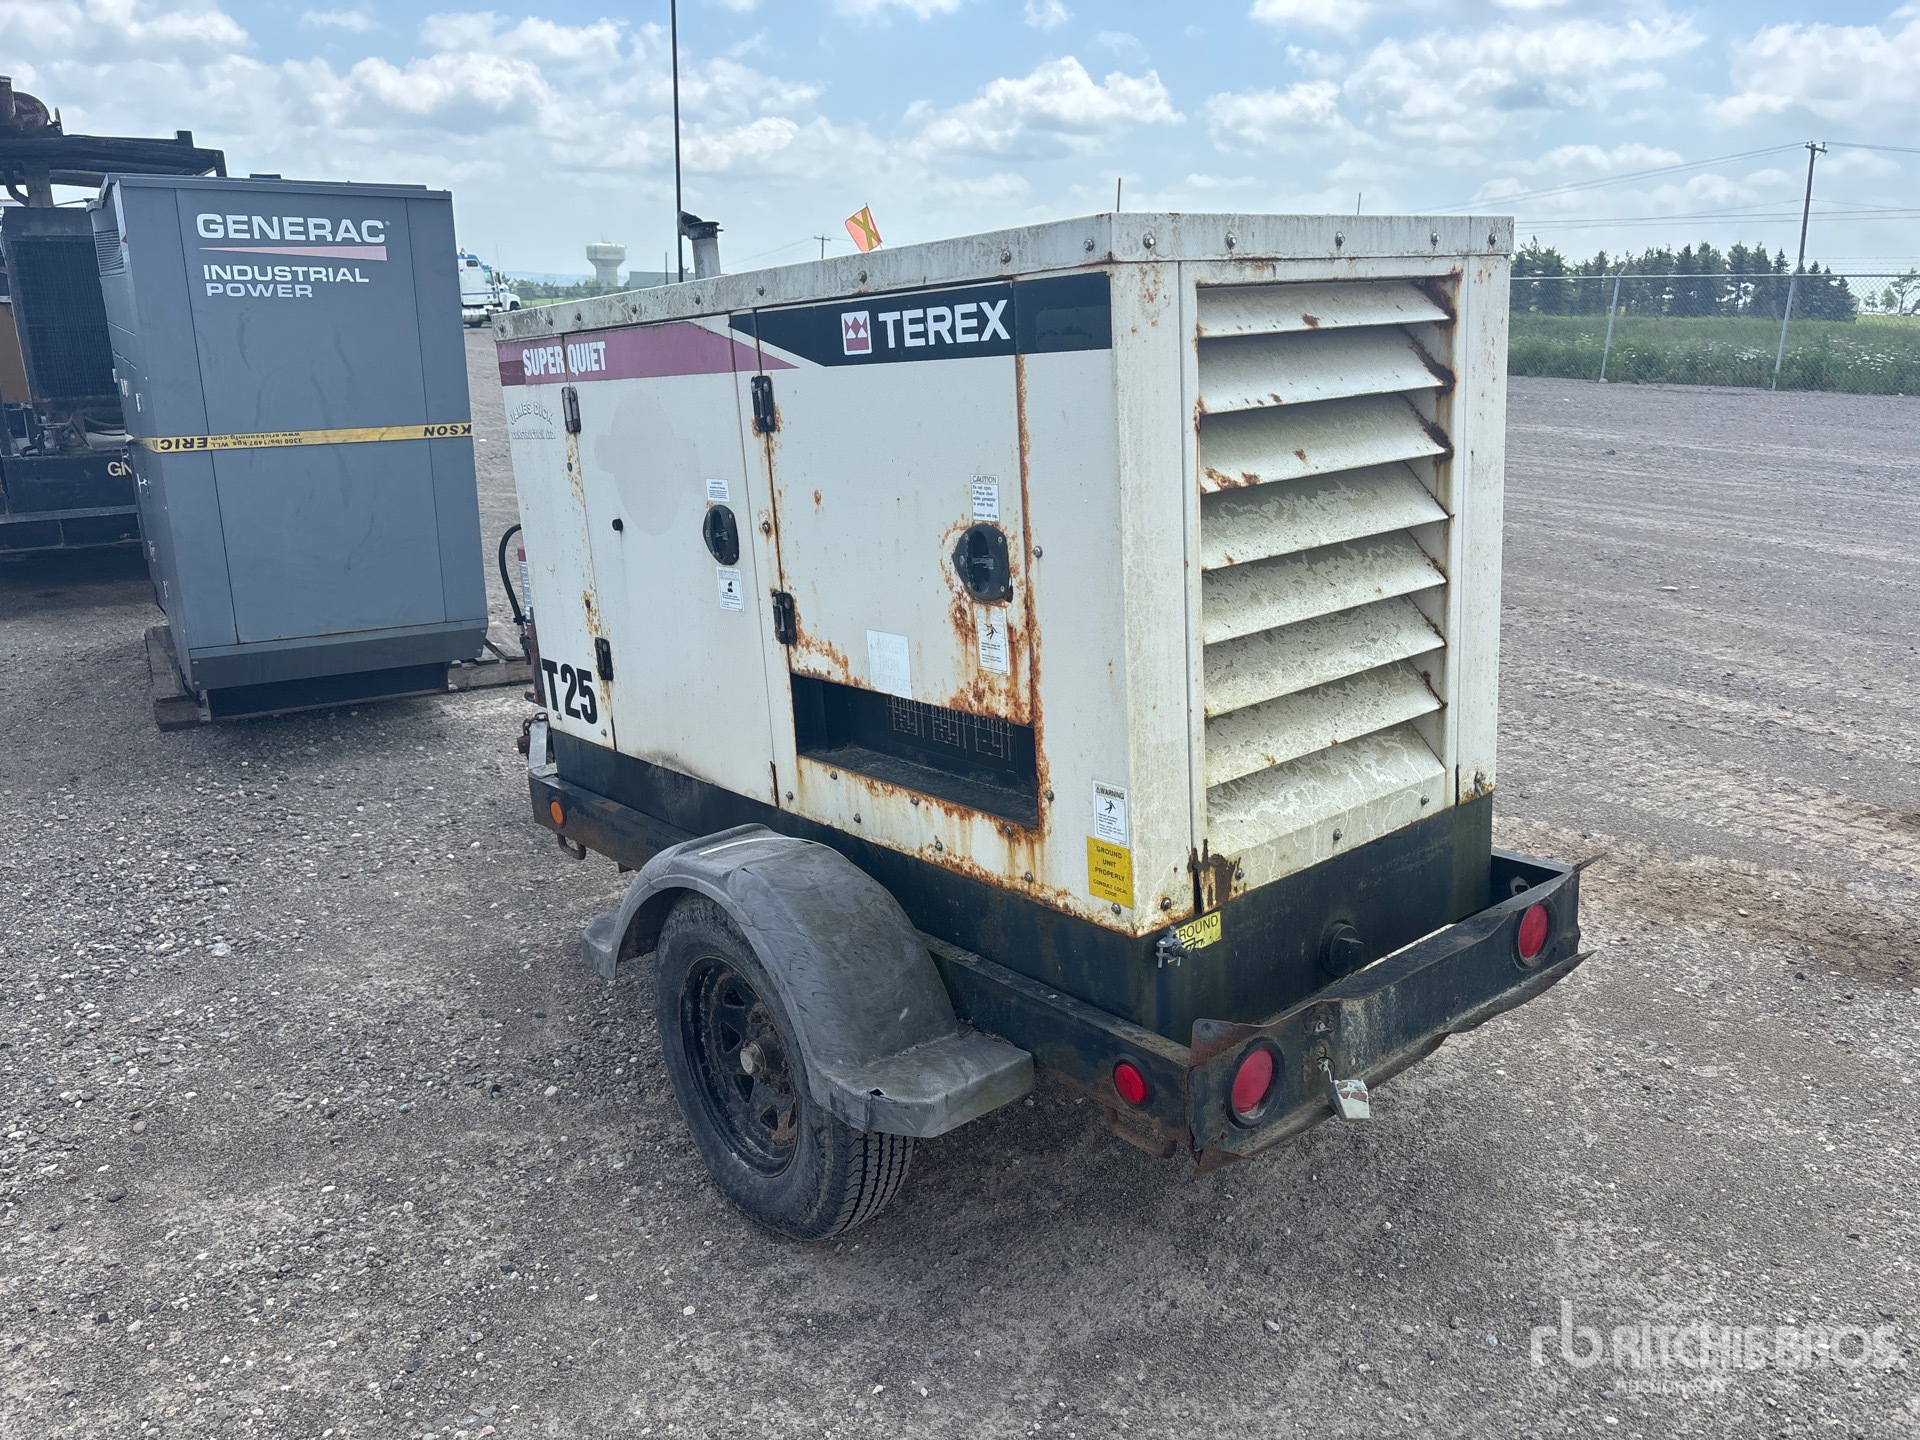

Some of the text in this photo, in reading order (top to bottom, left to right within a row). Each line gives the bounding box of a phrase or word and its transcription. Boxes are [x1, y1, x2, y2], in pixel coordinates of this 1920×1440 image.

[196, 213, 386, 243] GENERAC
[203, 264, 370, 283] INDUSTRIAL
[205, 283, 313, 298] POWER
[878, 300, 1011, 349] TEREX
[522, 341, 606, 377] SUPER QUIET
[424, 424, 472, 437] KSON
[160, 437, 208, 450] ERIC
[541, 657, 598, 725] T25
[1100, 787, 1125, 800] WARNING
[1096, 845, 1123, 859] GROUND
[1102, 858, 1117, 868] UNIT
[1094, 866, 1125, 882] PROPERLY
[1178, 915, 1219, 941] ROUND
